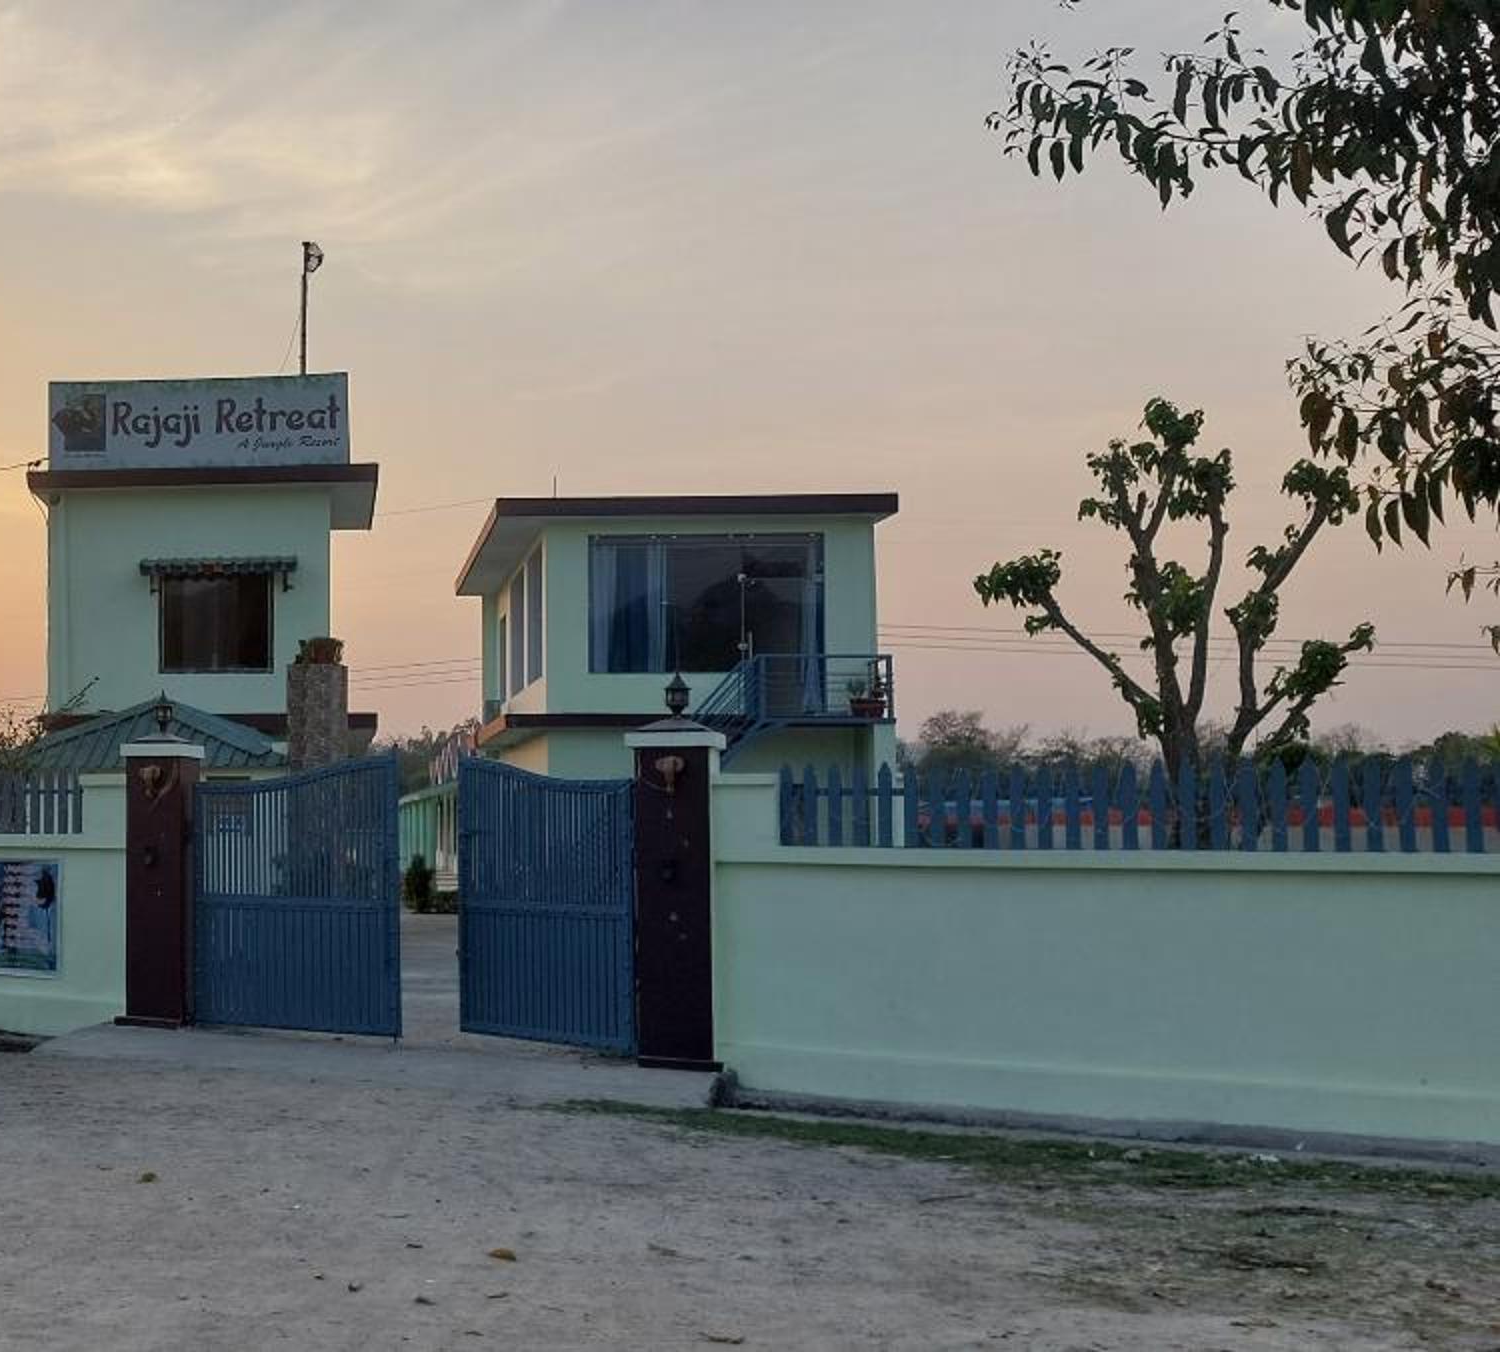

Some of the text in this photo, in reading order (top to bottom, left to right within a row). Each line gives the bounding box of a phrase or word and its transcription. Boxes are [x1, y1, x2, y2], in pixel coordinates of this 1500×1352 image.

[112, 394, 341, 448] Rajaji Retreat
[236, 437, 248, 451] A
[299, 433, 341, 448] Resort
